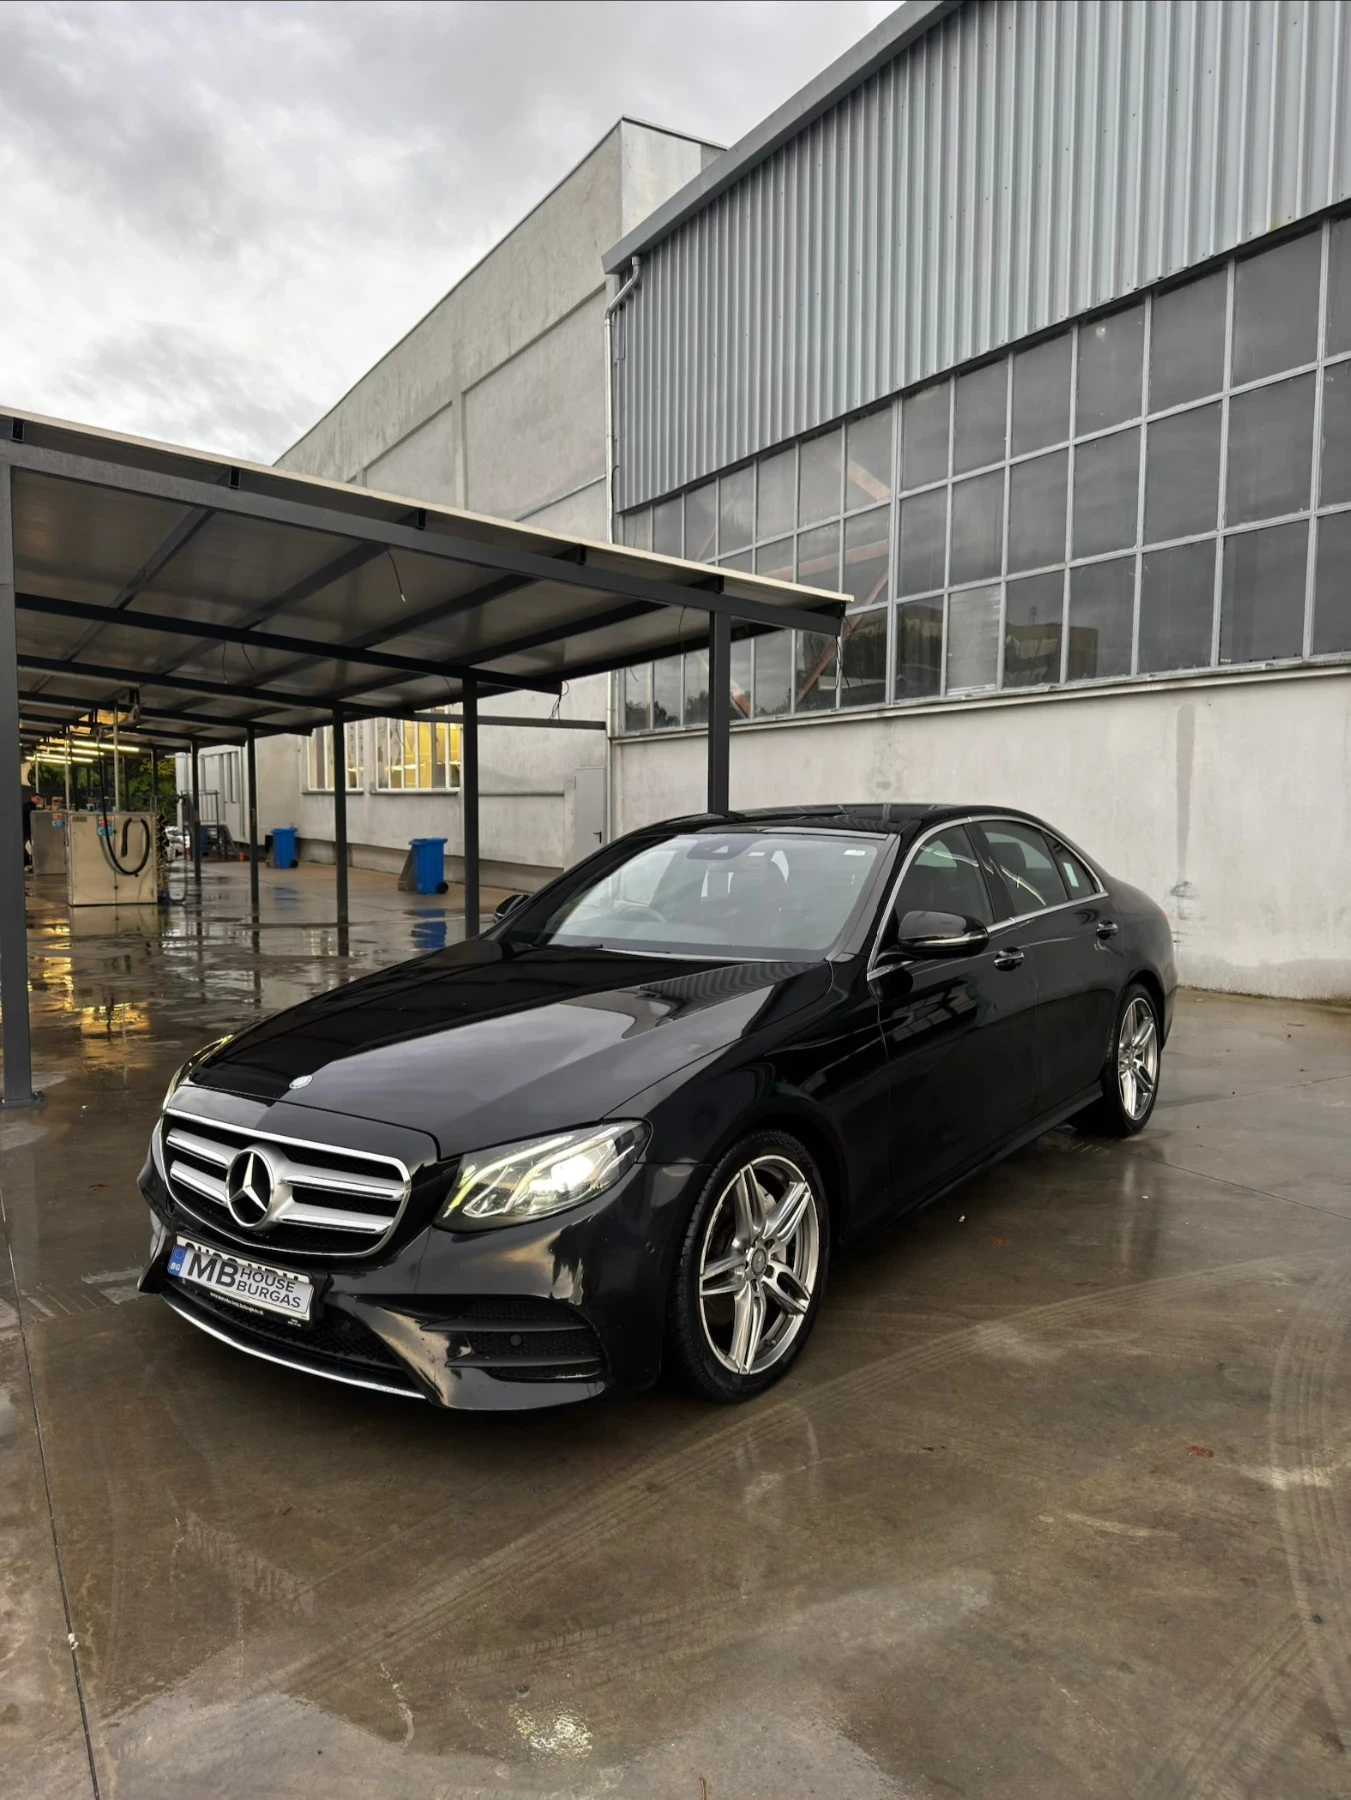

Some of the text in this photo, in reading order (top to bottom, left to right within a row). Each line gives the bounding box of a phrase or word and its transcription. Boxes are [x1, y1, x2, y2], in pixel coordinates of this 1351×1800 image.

[170, 1262, 181, 1271] BG
[187, 1252, 239, 1288] MB
[240, 1267, 296, 1293] HOUSE
[236, 1279, 302, 1309] BURGAS
